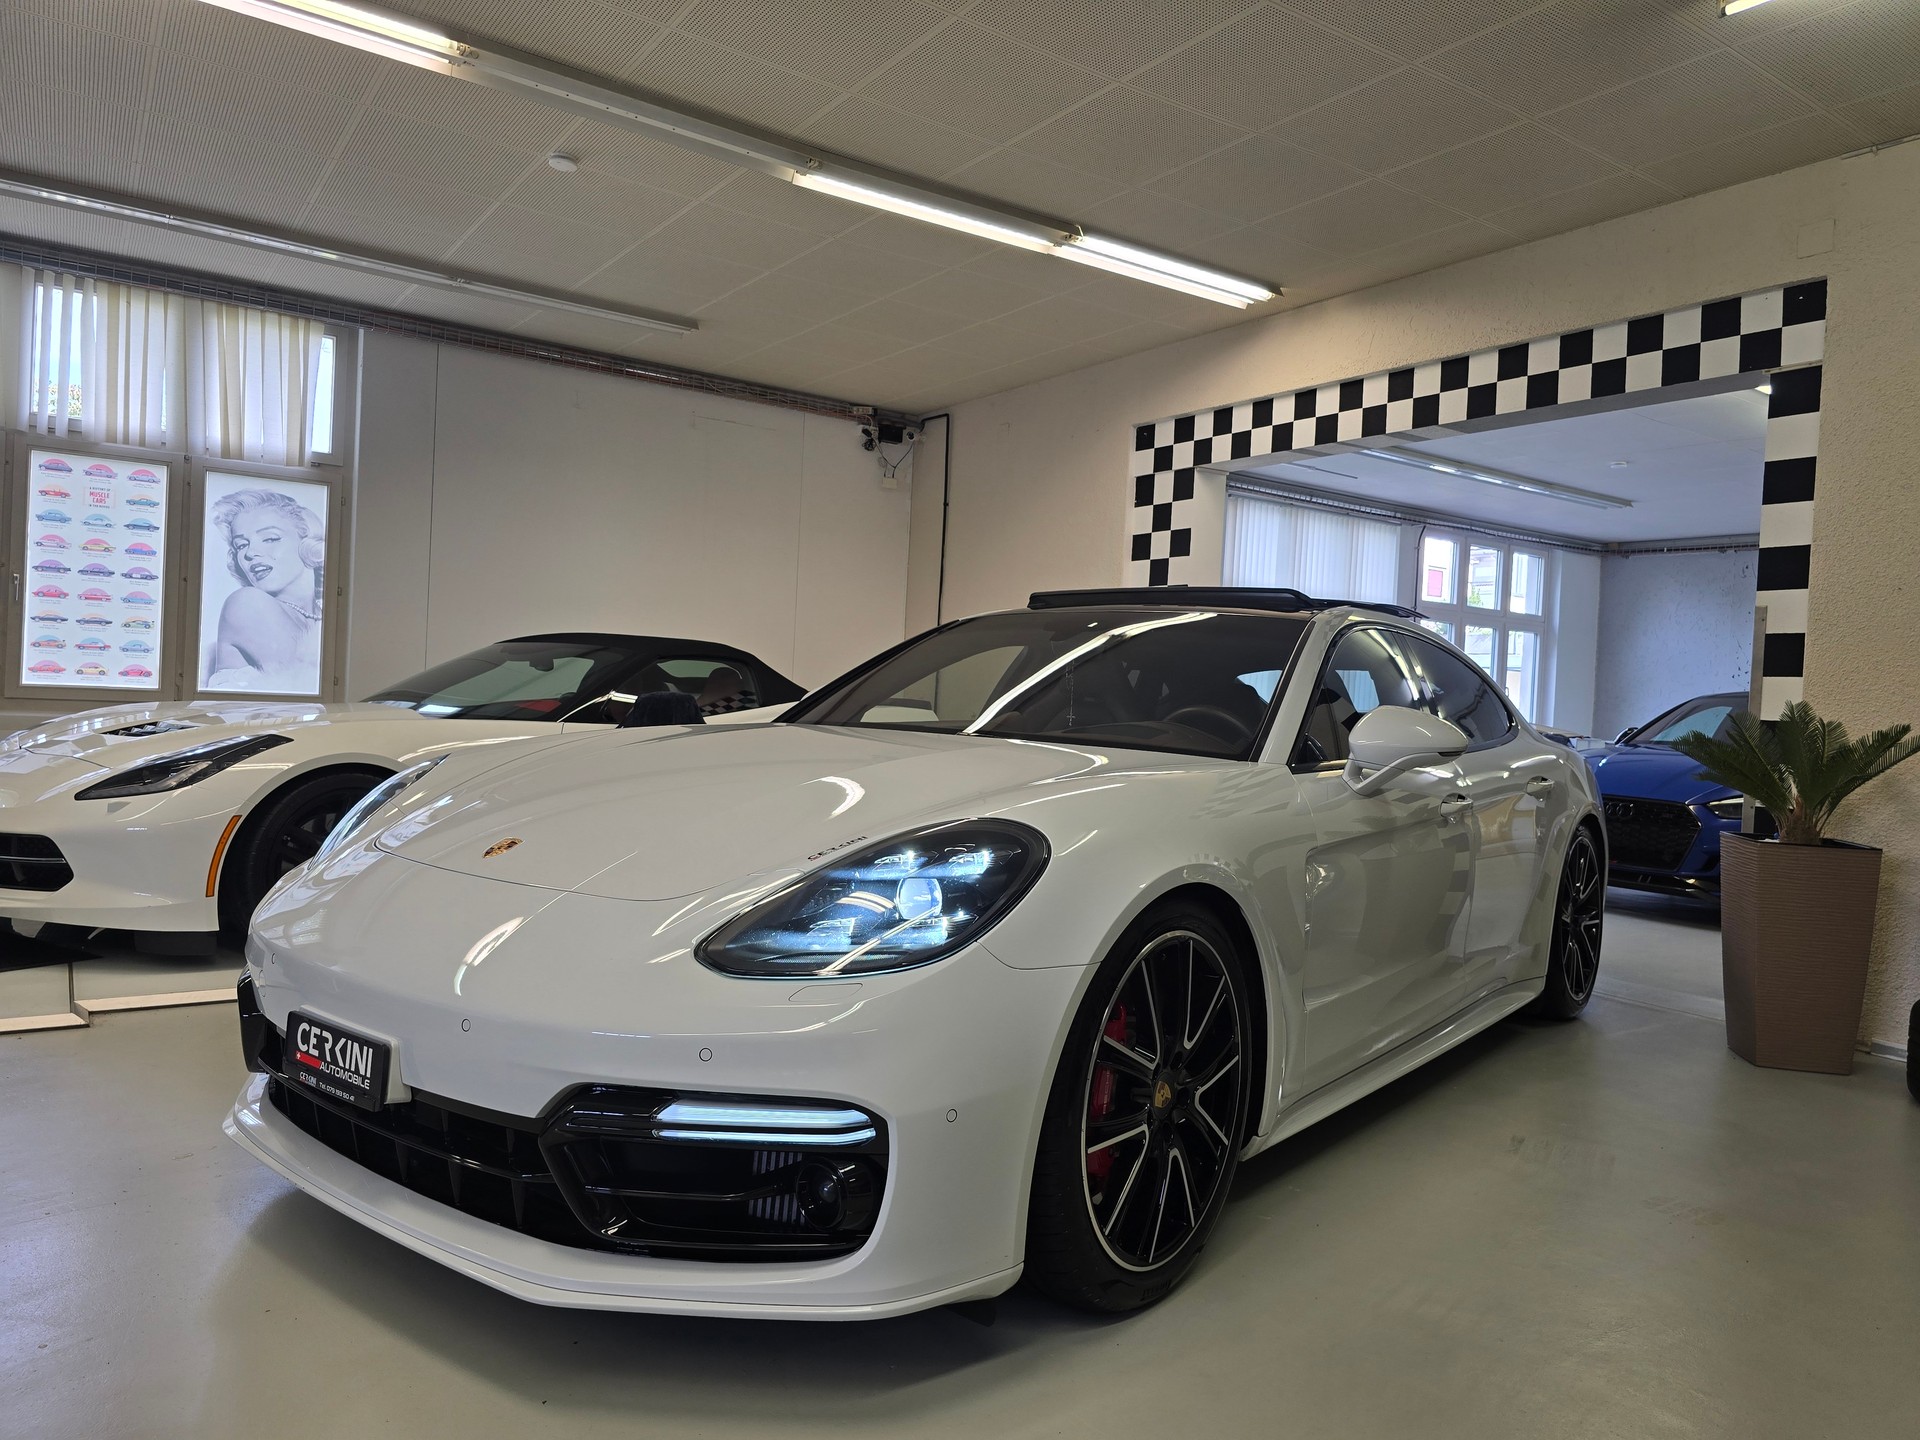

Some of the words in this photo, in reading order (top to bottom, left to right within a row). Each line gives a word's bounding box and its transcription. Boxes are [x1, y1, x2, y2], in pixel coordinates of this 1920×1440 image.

[89, 491, 110, 499] MUSCLE
[297, 1022, 373, 1078] CERKINI
[319, 1061, 370, 1090] AUTOMOBILE
